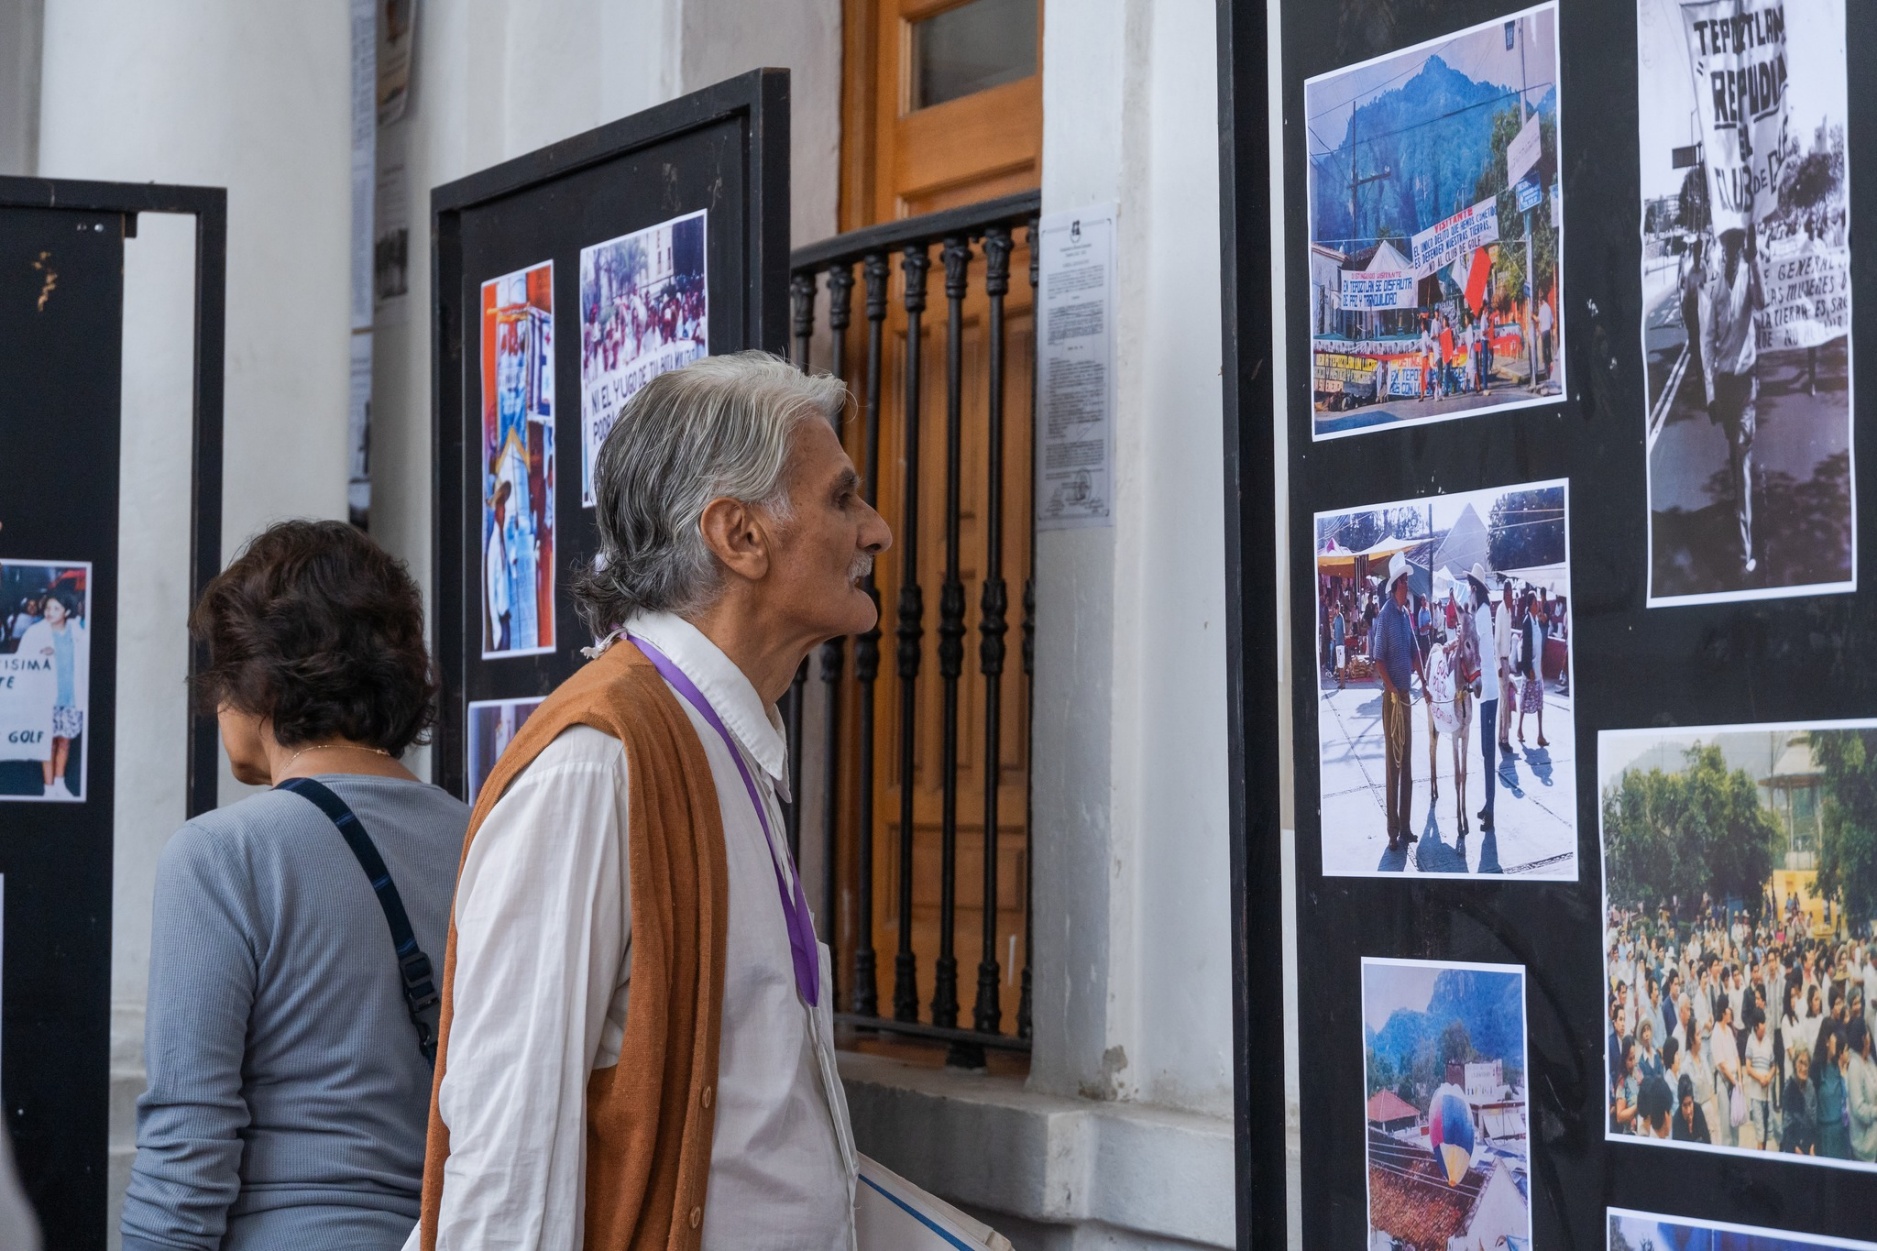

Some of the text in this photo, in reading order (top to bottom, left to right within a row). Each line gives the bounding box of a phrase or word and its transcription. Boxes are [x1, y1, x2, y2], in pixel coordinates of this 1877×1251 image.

[1693, 4, 1785, 56] TEPOZTLAN
[1710, 51, 1787, 122] REPUDIA
[1753, 169, 1768, 195] DE
[1433, 206, 1473, 233] VISITANTE
[1413, 245, 1420, 257] EL
[1434, 228, 1449, 245] DELITO
[1460, 216, 1475, 230] HEMOS
[1414, 257, 1421, 270] ES
[1422, 243, 1444, 265] DEFENDER
[1446, 231, 1468, 250] NUESTRAS
[1428, 235, 1481, 272] NO AL CLUB DE GOLF
[1778, 255, 1834, 281] GENERAL
[1375, 280, 1382, 292] SE
[1383, 276, 1412, 292] DISFRUTA
[1786, 275, 1835, 301] MUJERES
[1774, 304, 1808, 327] TIERRA
[601, 384, 611, 410] EL
[613, 371, 637, 400] YUGO
[639, 364, 647, 389] DE
[8, 729, 44, 744] GOLF
